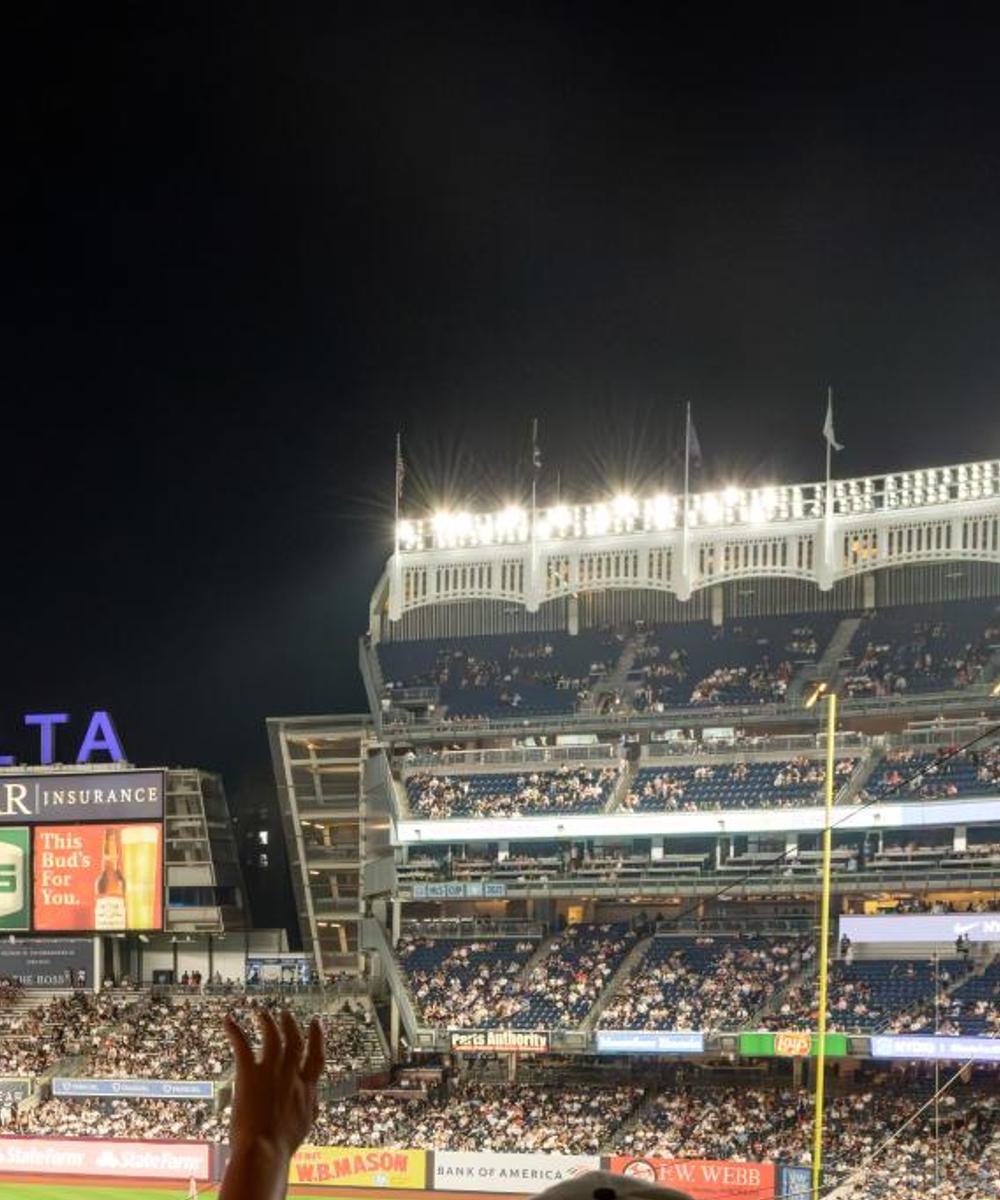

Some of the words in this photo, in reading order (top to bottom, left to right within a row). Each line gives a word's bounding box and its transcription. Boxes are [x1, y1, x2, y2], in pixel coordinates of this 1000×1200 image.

[43, 787, 158, 806] INSURANCE
[41, 833, 83, 849] This
[42, 851, 91, 868] Bud's
[41, 871, 71, 887] For
[41, 892, 80, 906] You.
[487, 1031, 548, 1048] Authority
[437, 1166, 474, 1177] BANK
[478, 1167, 496, 1178] OF
[500, 1167, 563, 1180] AMERICA
[703, 1166, 761, 1186] WEBB
